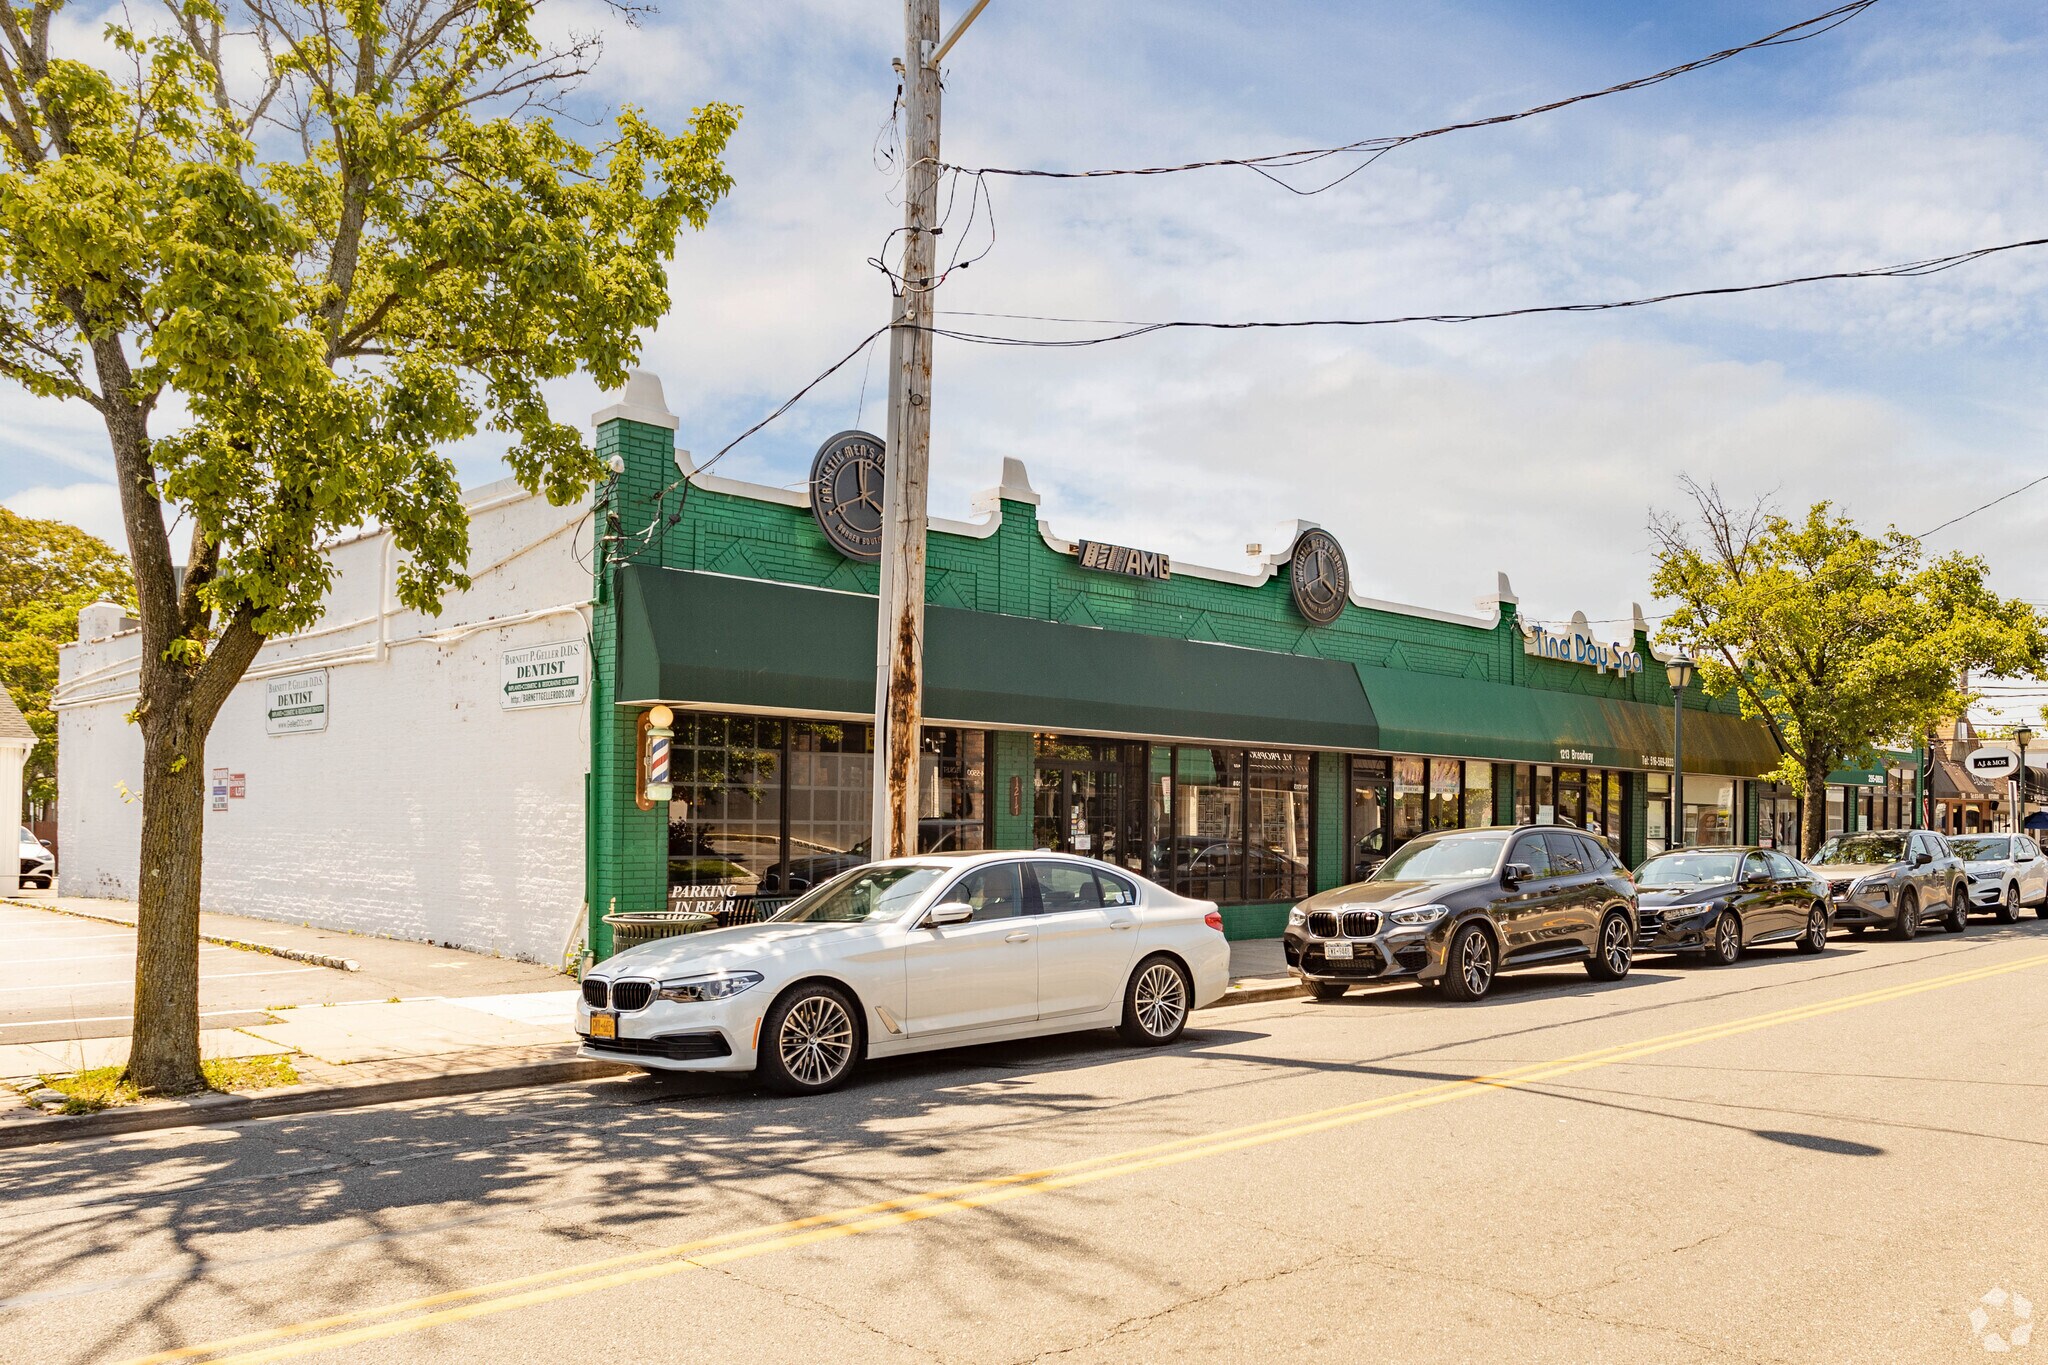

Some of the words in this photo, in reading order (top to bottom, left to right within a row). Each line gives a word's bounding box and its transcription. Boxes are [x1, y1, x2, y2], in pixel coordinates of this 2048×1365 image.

[821, 450, 844, 503] ARTISTIC
[844, 444, 875, 459] MEN'S
[836, 522, 862, 545] BARBER
[505, 653, 529, 665] BARNETT
[530, 650, 536, 662] P.
[536, 649, 559, 661] GELLER
[560, 645, 580, 657] D.D.S.
[1532, 625, 1572, 660] Tina
[1575, 633, 1608, 674] Day
[1612, 641, 1643, 678] Spa
[517, 661, 565, 678] DENTIST
[268, 683, 287, 694] BARNETT
[278, 690, 312, 707] DENTIST
[1560, 749, 1570, 761] 1213
[1571, 749, 1594, 763] Broadway
[671, 884, 738, 898] PARKING
[675, 901, 693, 912] IN
[695, 900, 736, 912] REAR
